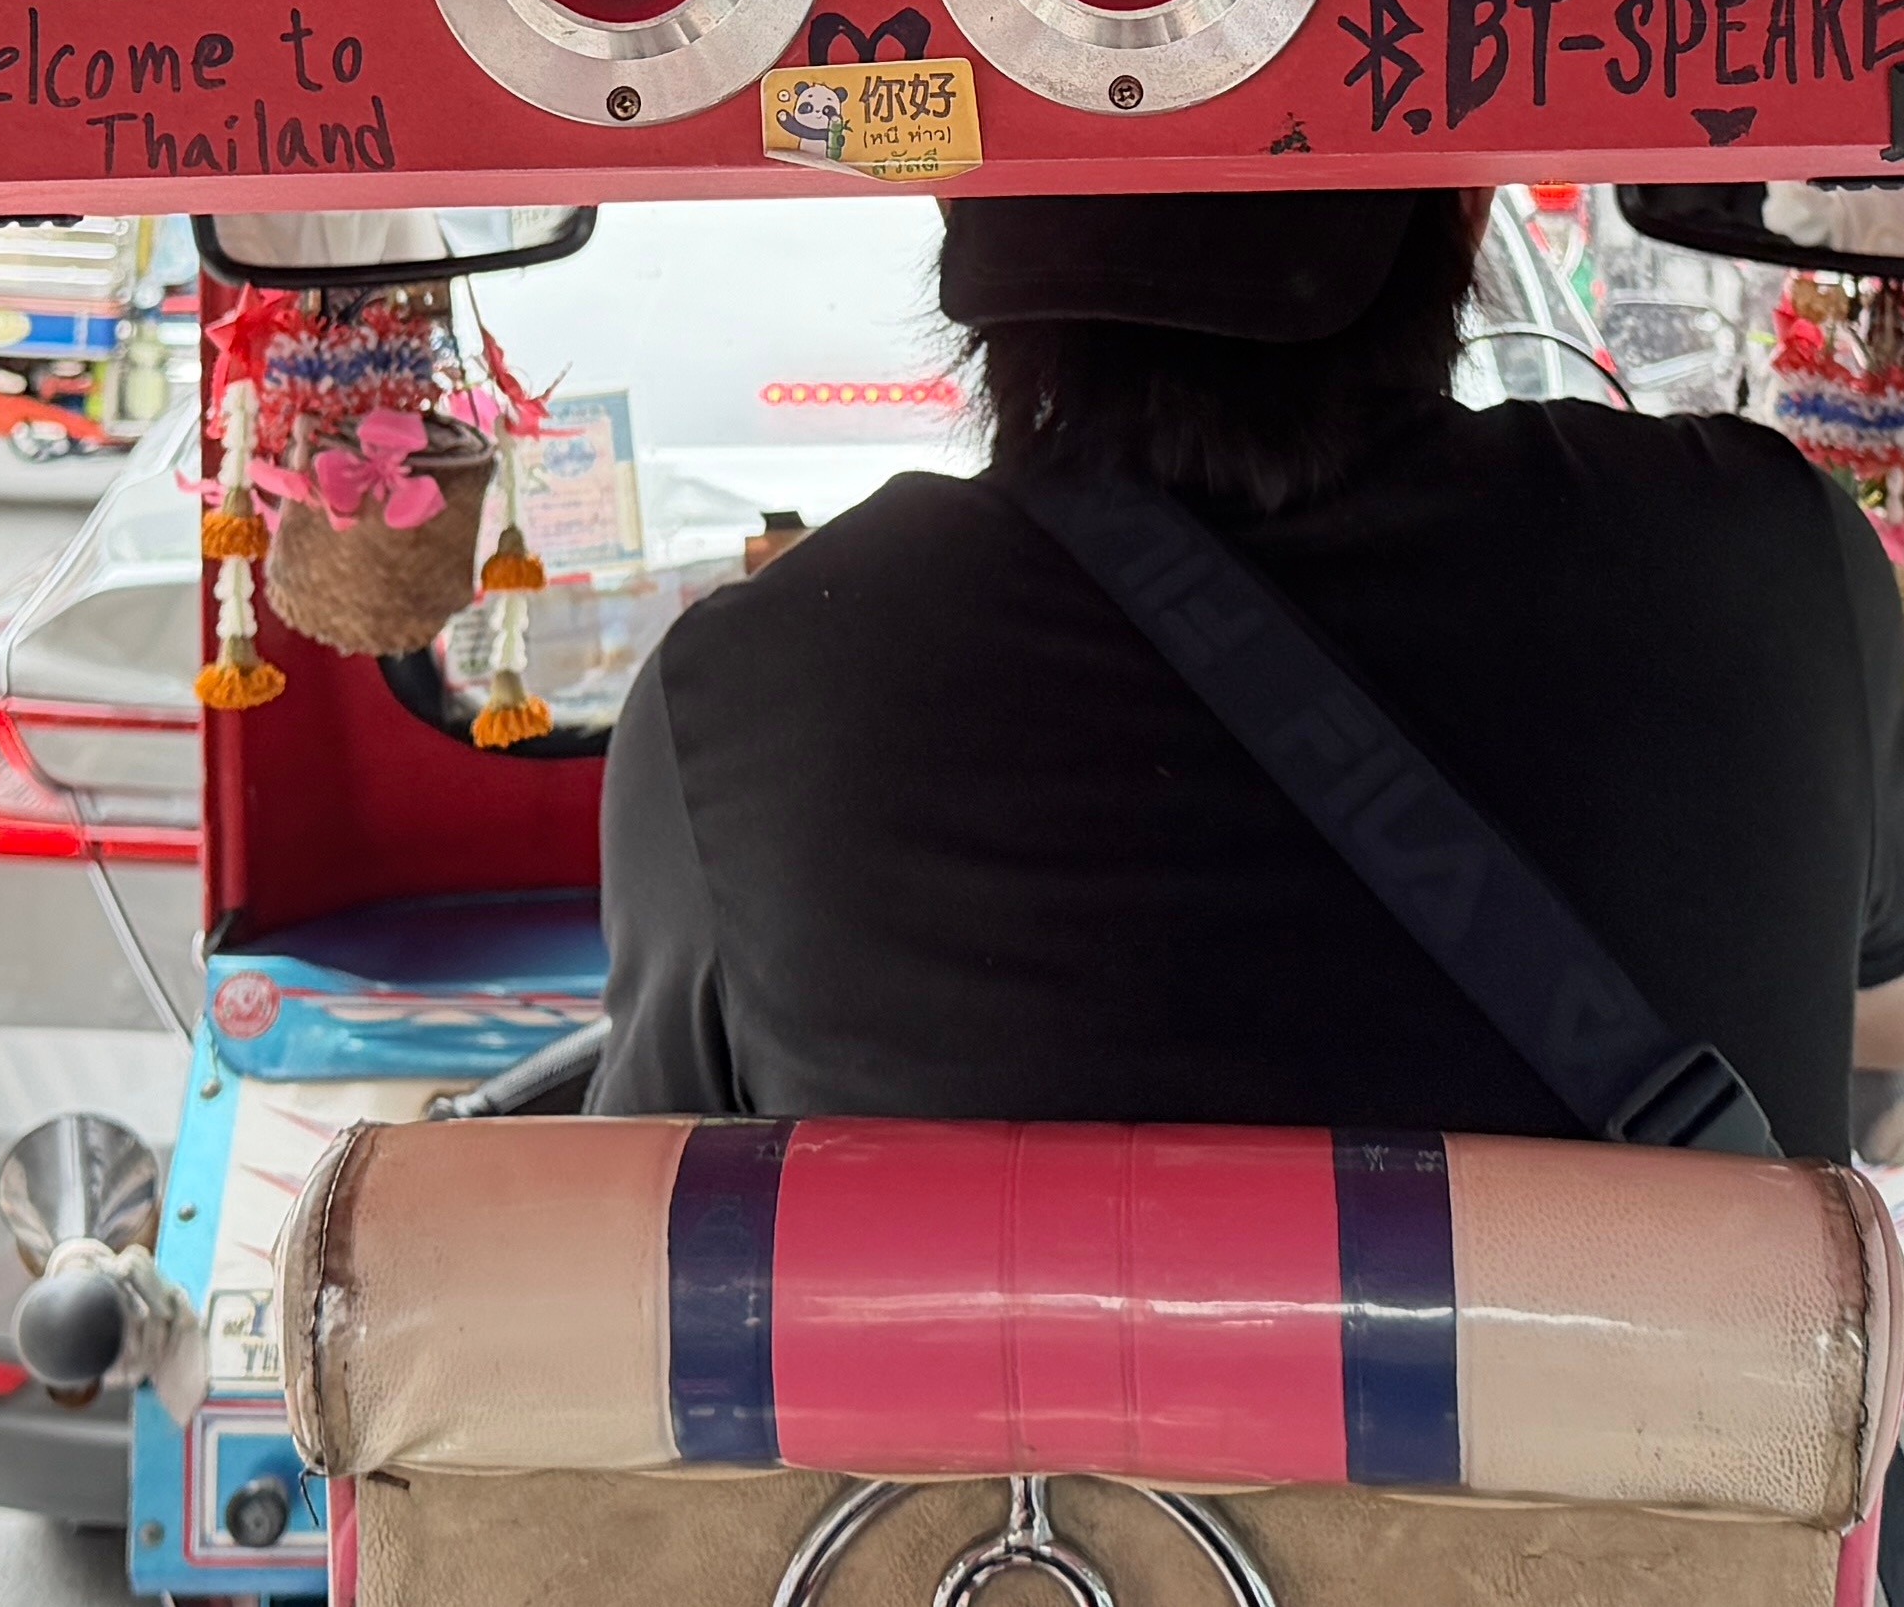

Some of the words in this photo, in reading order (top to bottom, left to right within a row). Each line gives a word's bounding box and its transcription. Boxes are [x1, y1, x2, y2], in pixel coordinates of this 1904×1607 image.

[279, 8, 363, 92] to
[86, 96, 397, 176] Thailand
[859, 73, 956, 124] 你好
[1266, 689, 1489, 945] FILA
